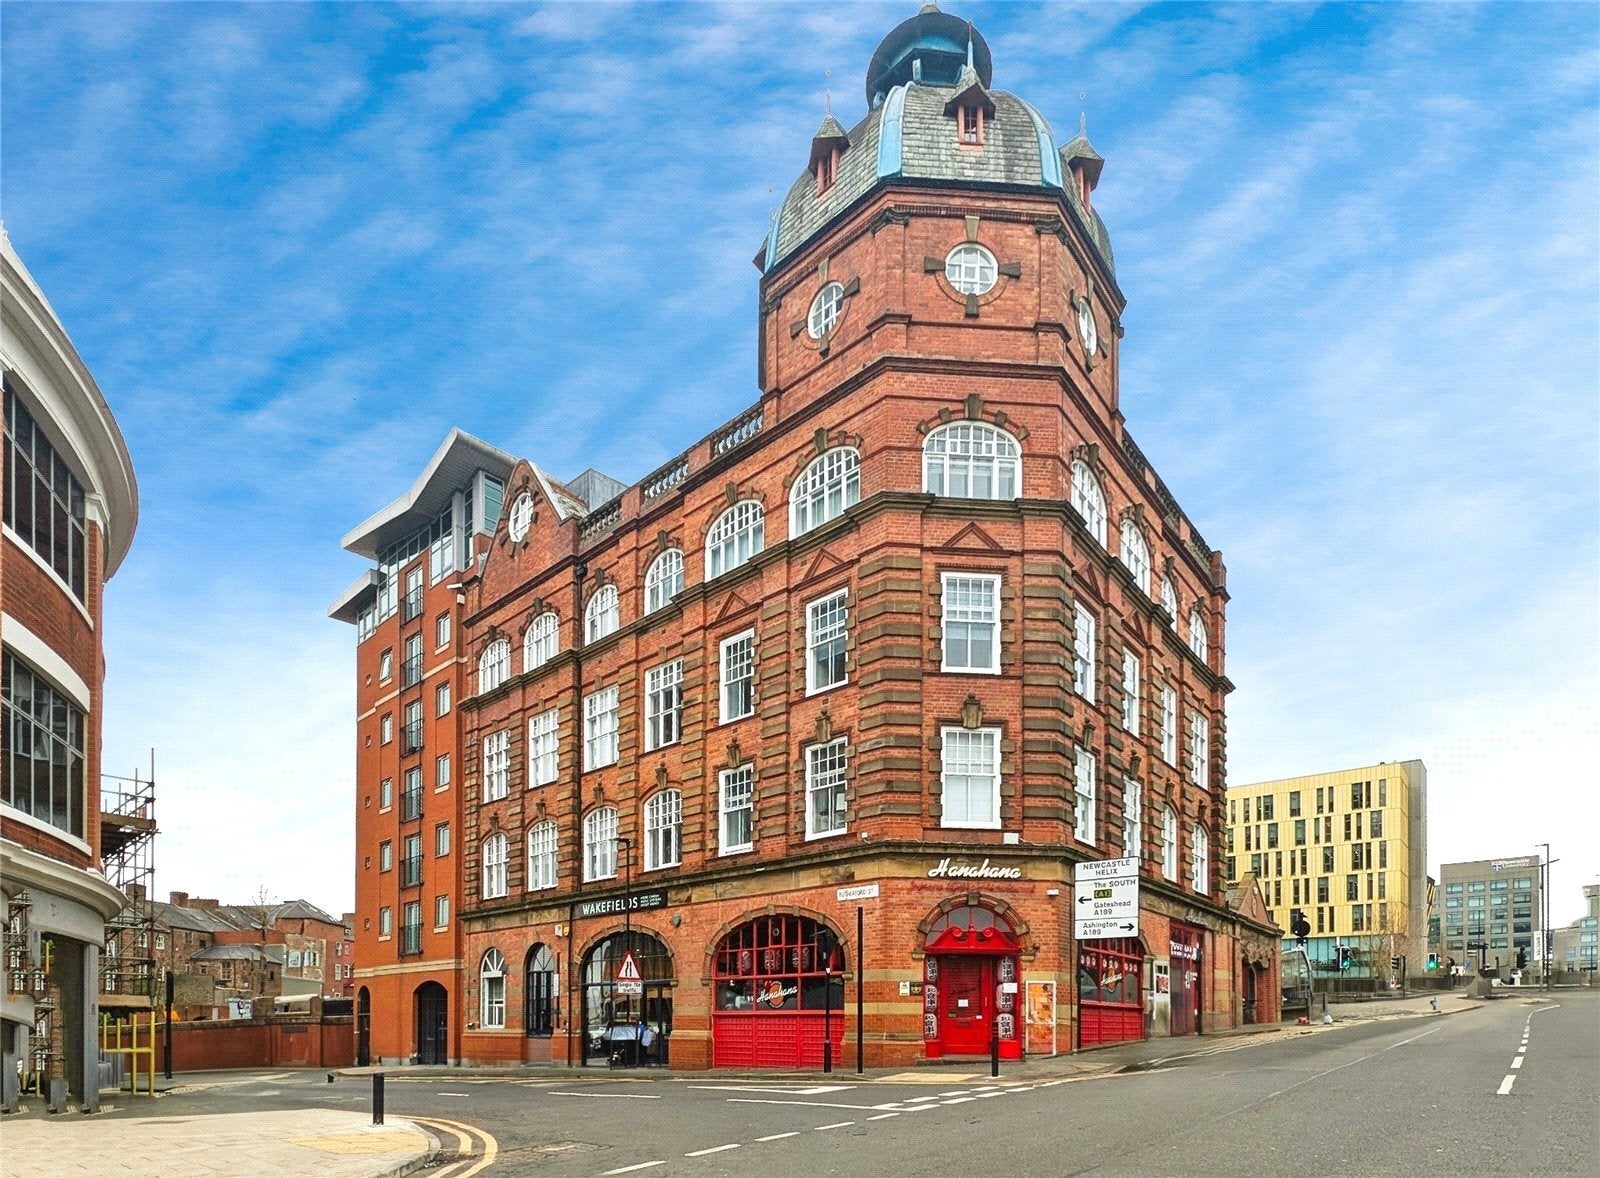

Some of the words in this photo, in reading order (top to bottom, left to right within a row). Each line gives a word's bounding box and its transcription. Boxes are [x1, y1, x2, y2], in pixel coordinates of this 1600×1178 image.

[928, 858, 1021, 879] Hanahana
[1083, 860, 1130, 870] NEWCASTLE
[1095, 868, 1118, 876] HELIX
[1109, 879, 1136, 888] SOUTH
[1095, 890, 1112, 898] (A1)
[1094, 900, 1131, 908] Gateshead
[1094, 908, 1112, 916] A189
